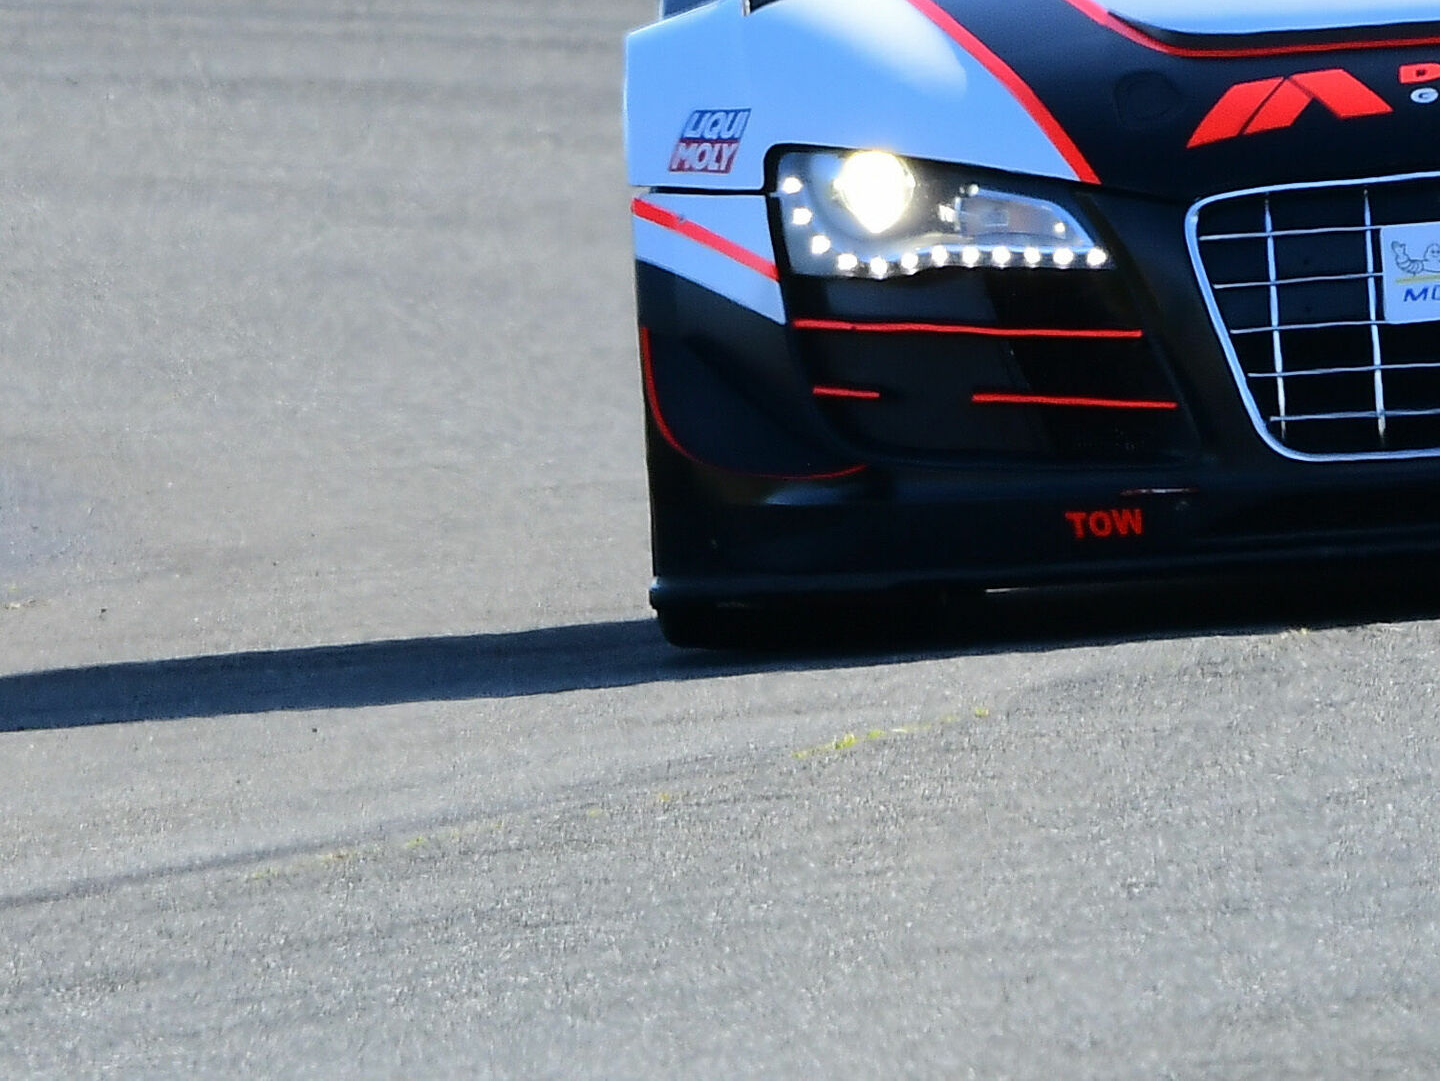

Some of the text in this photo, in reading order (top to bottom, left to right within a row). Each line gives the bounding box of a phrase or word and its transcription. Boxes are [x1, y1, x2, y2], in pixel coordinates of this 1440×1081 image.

[682, 111, 750, 139] LIQUI
[671, 143, 739, 171] MOLY
[1065, 509, 1142, 539] TOW
